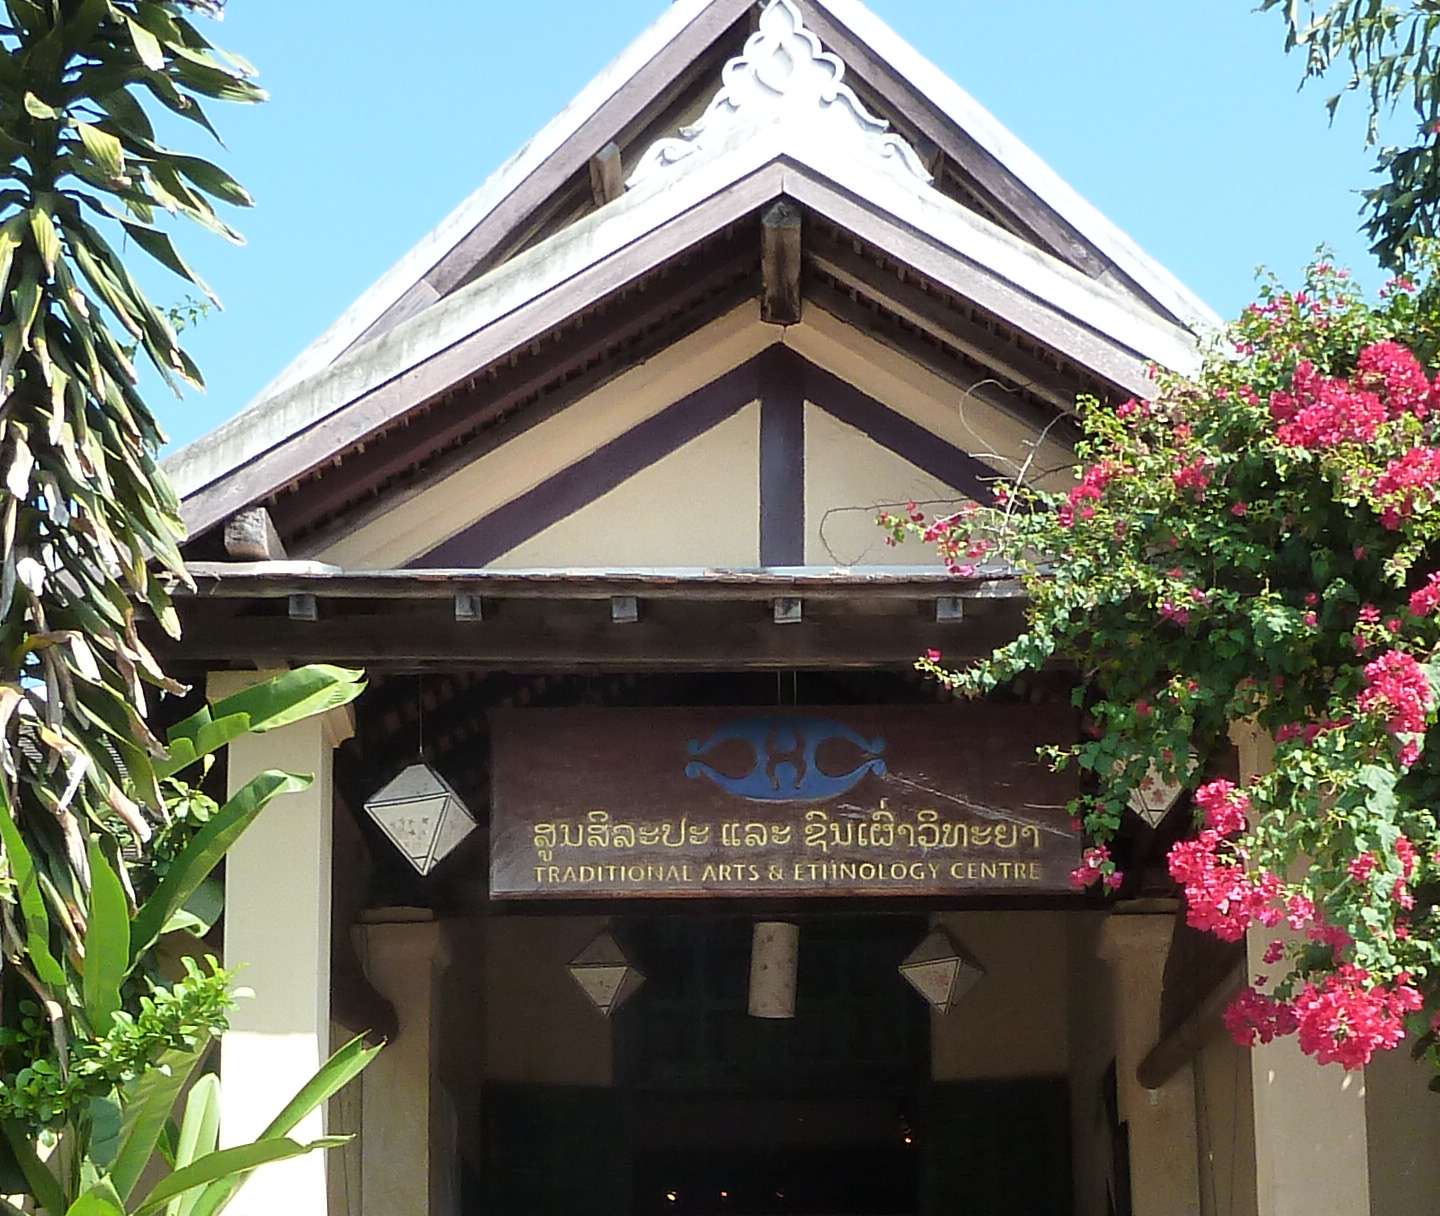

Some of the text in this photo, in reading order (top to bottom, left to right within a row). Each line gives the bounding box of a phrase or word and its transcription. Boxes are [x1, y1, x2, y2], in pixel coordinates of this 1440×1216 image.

[722, 822, 791, 847] ແລະ
[533, 862, 1041, 882] TRADITIONAL ARTS & ETHNOLOGY CENTRE
